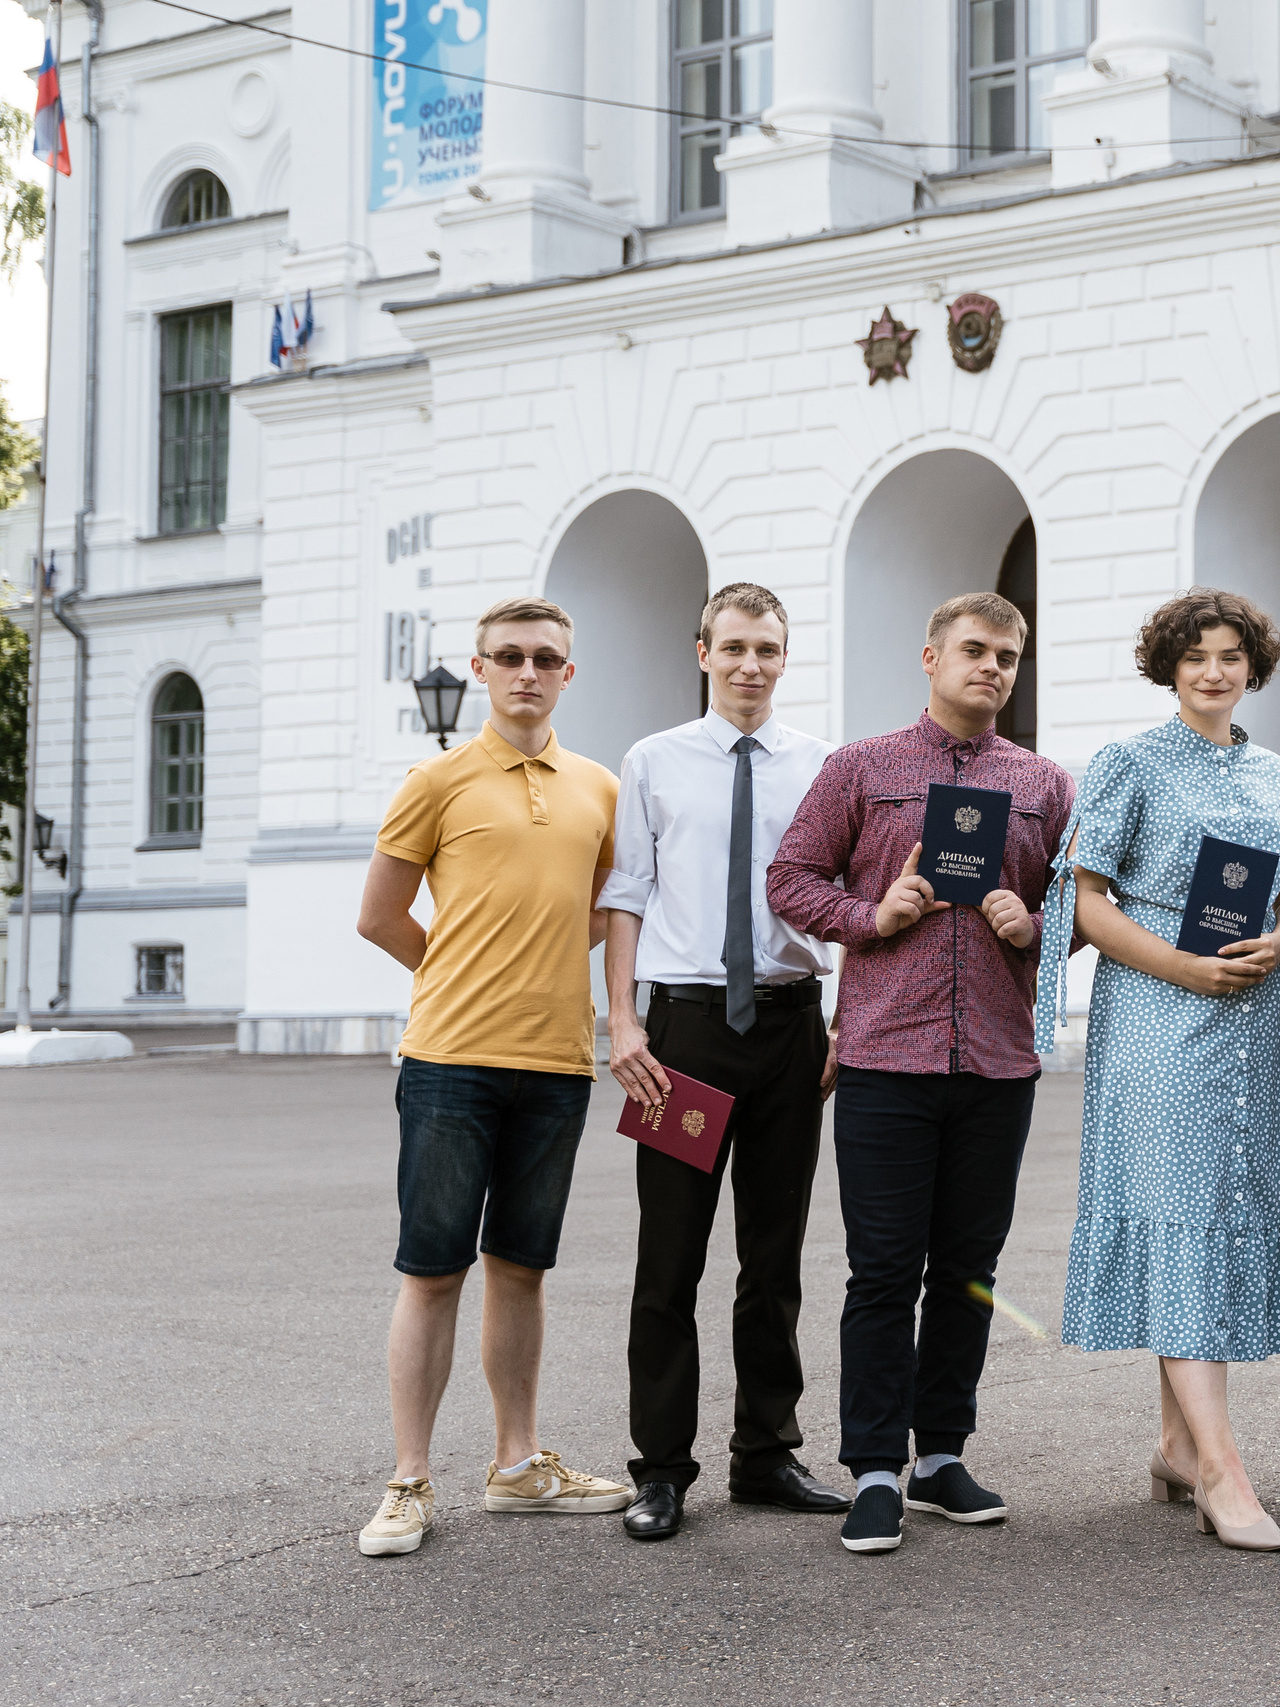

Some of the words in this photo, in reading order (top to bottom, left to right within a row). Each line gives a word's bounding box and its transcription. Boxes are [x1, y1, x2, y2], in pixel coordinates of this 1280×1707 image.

[418, 91, 483, 120] ФОРУМ
[418, 113, 483, 141] МОЛОД
[384, 610, 432, 683] 187
[937, 851, 985, 865] ДИПЛОМ
[935, 867, 981, 879] ОБРАЗОВАНИИ
[948, 863, 977, 872] ВЫСШЕМ
[1202, 904, 1248, 924] ДИПЛОМ
[1198, 920, 1242, 937] ОБРАЗОВАНИИ
[1211, 917, 1239, 929] ВЫСШЕМ
